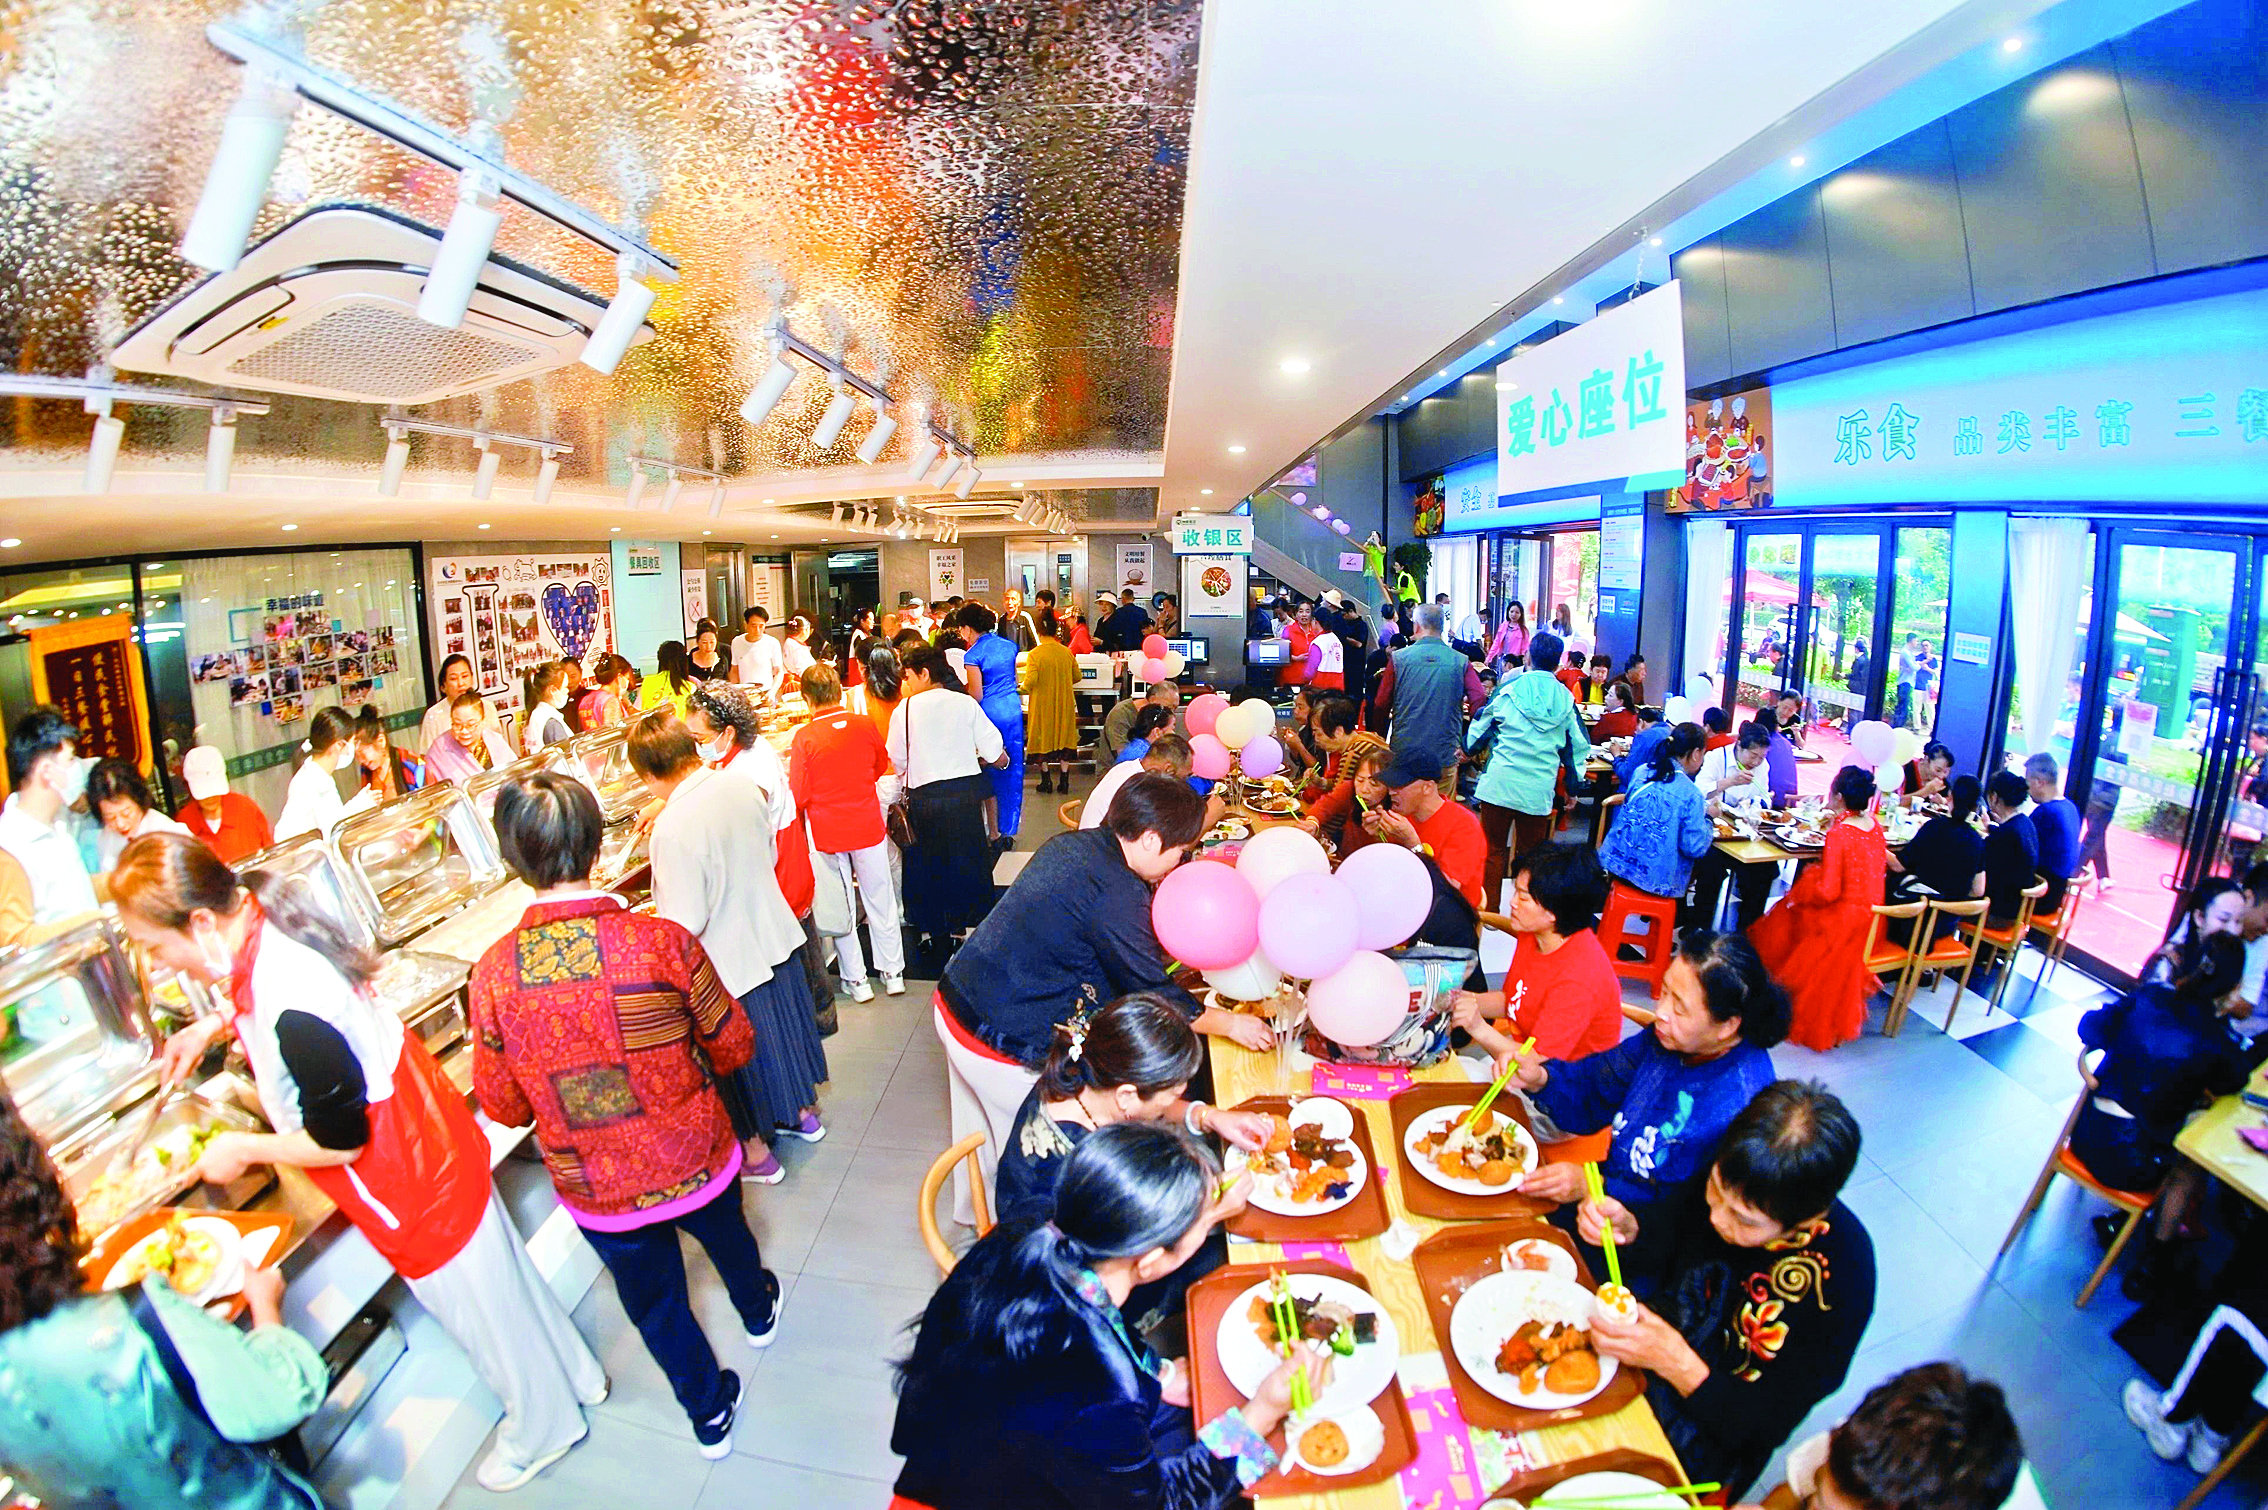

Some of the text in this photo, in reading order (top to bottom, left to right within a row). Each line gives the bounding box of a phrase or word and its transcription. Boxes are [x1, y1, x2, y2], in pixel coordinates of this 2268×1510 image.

[1508, 349, 1667, 457] 爱心座位
[1834, 403, 1919, 465] 乐食
[1954, 400, 2134, 456] 品类丰富
[1182, 528, 1243, 546] 收银区
[629, 556, 661, 570] 餐具回收区
